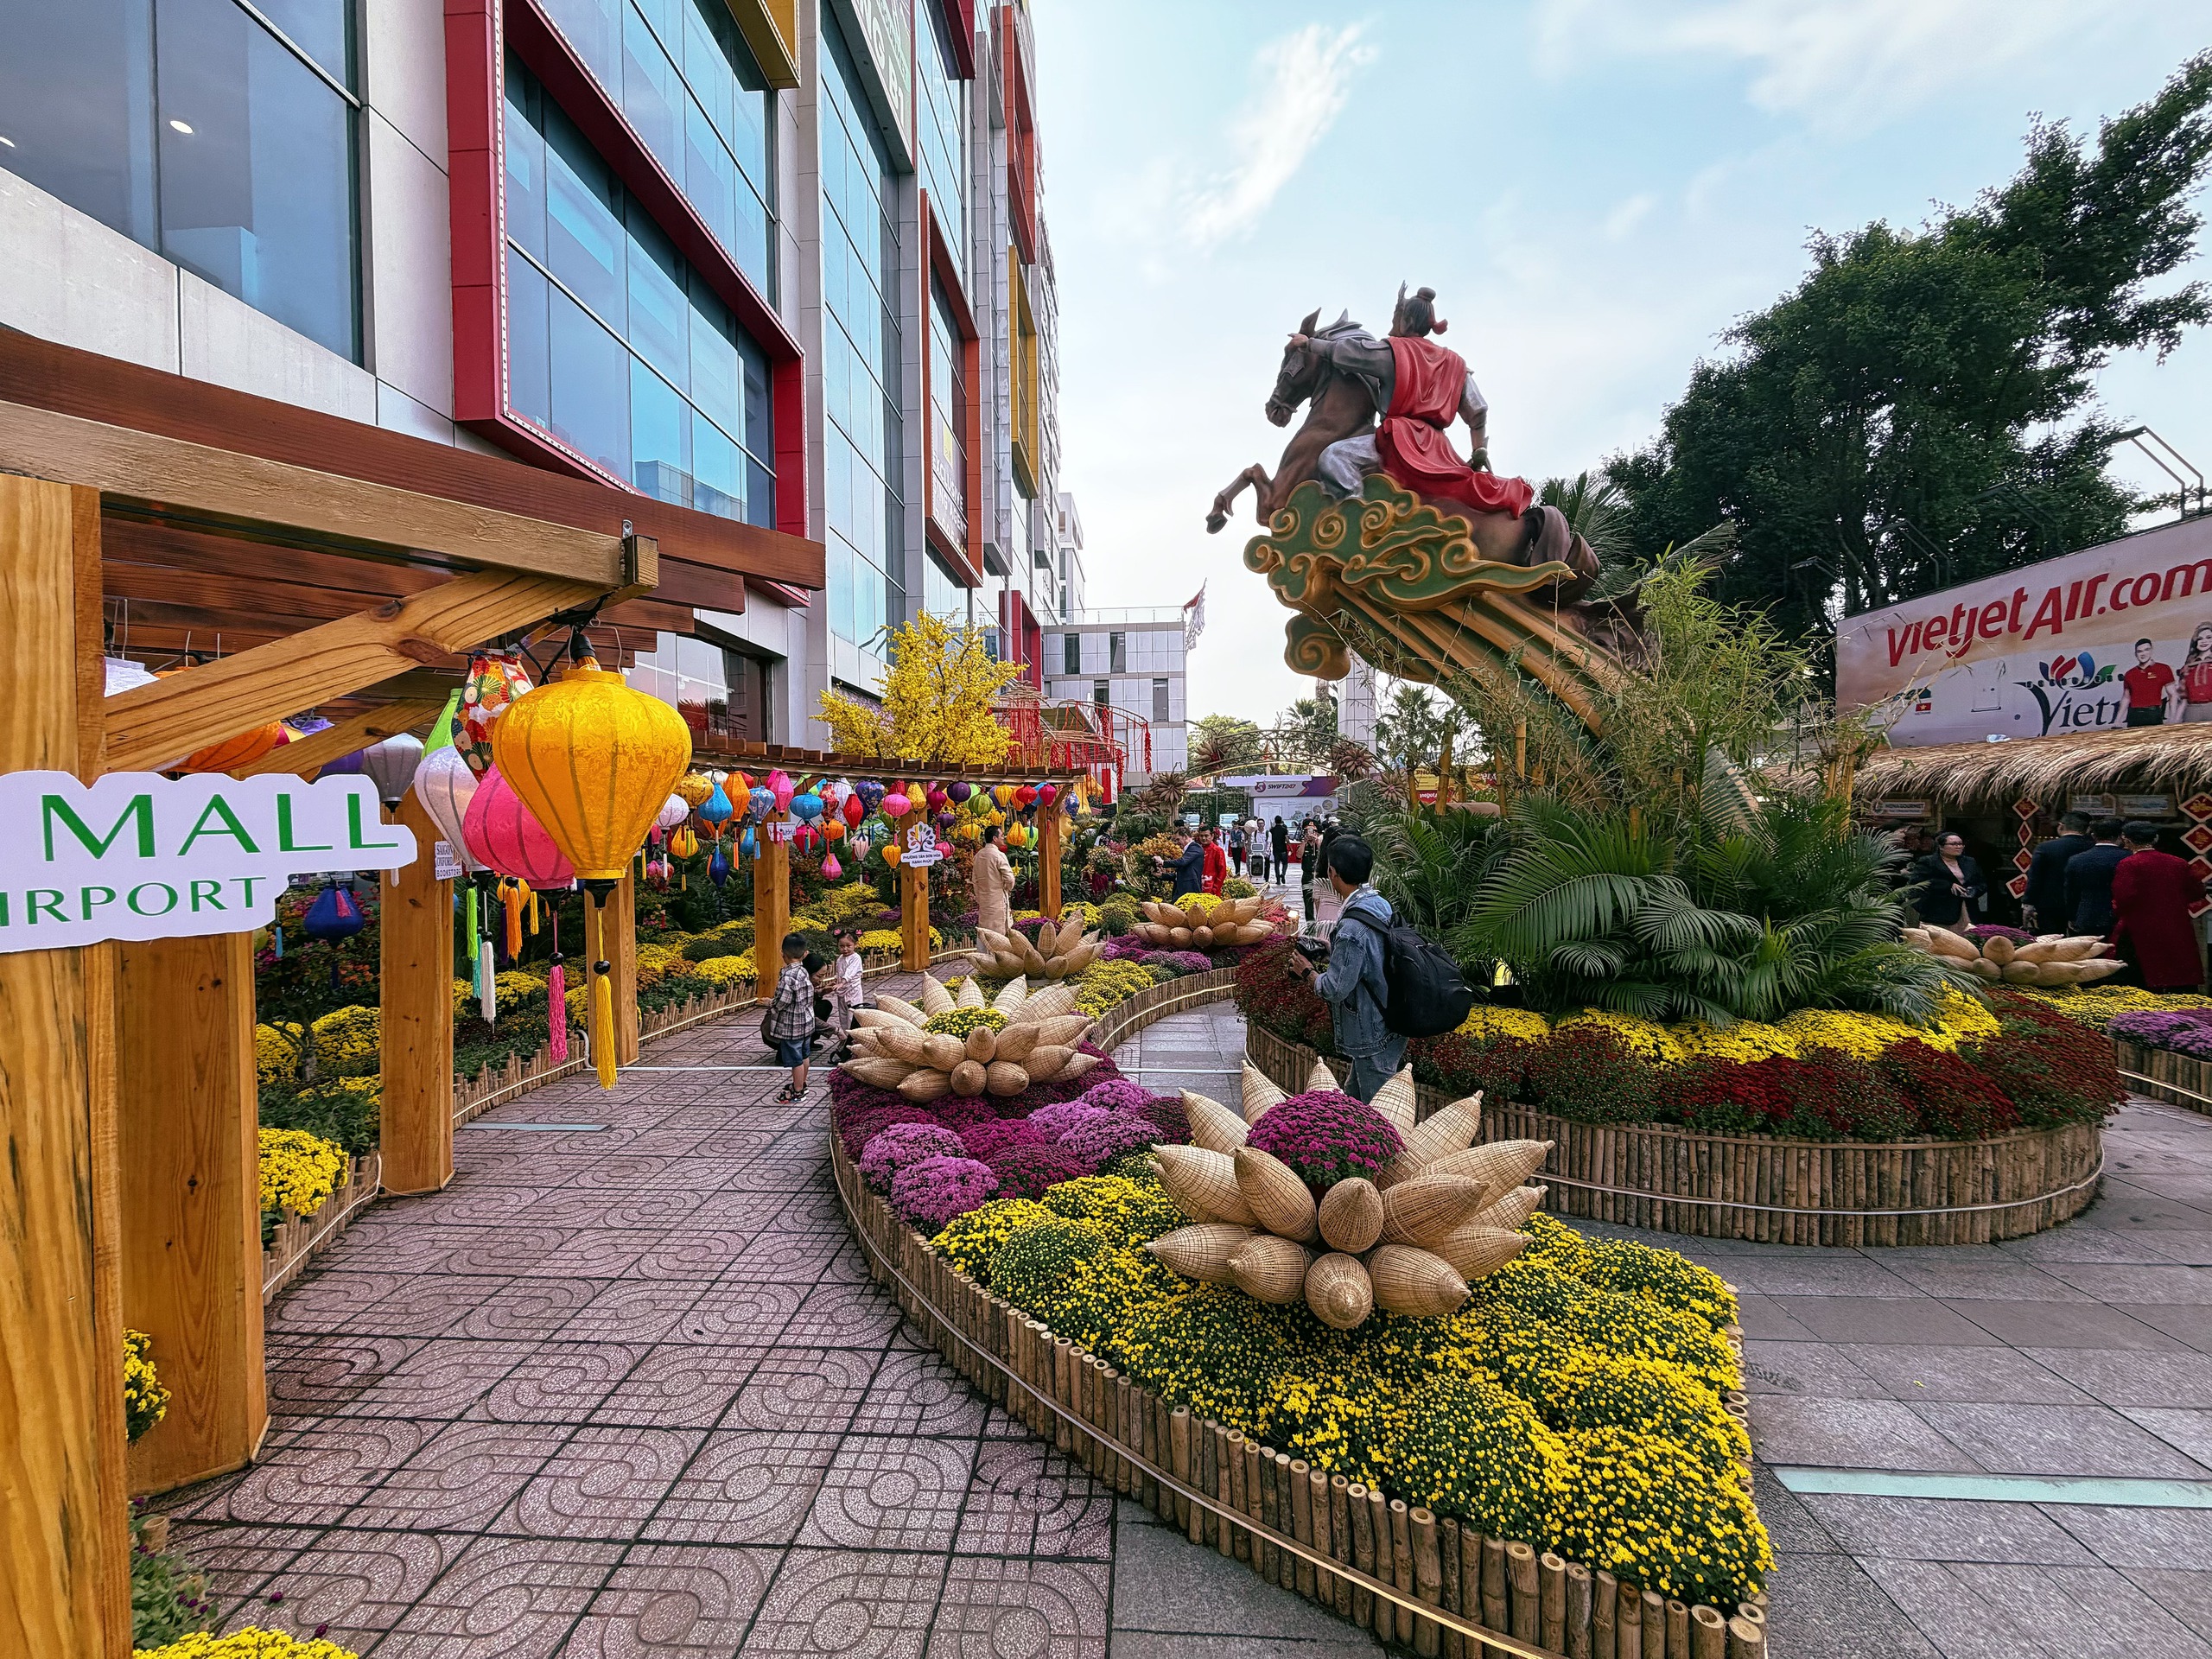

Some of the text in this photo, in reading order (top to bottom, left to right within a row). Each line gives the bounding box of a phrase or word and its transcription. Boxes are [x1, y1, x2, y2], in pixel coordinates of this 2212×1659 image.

[41, 793, 399, 861] MALL
[436, 868, 461, 877] BOOKSTORE
[0, 877, 266, 927] IRPORT
